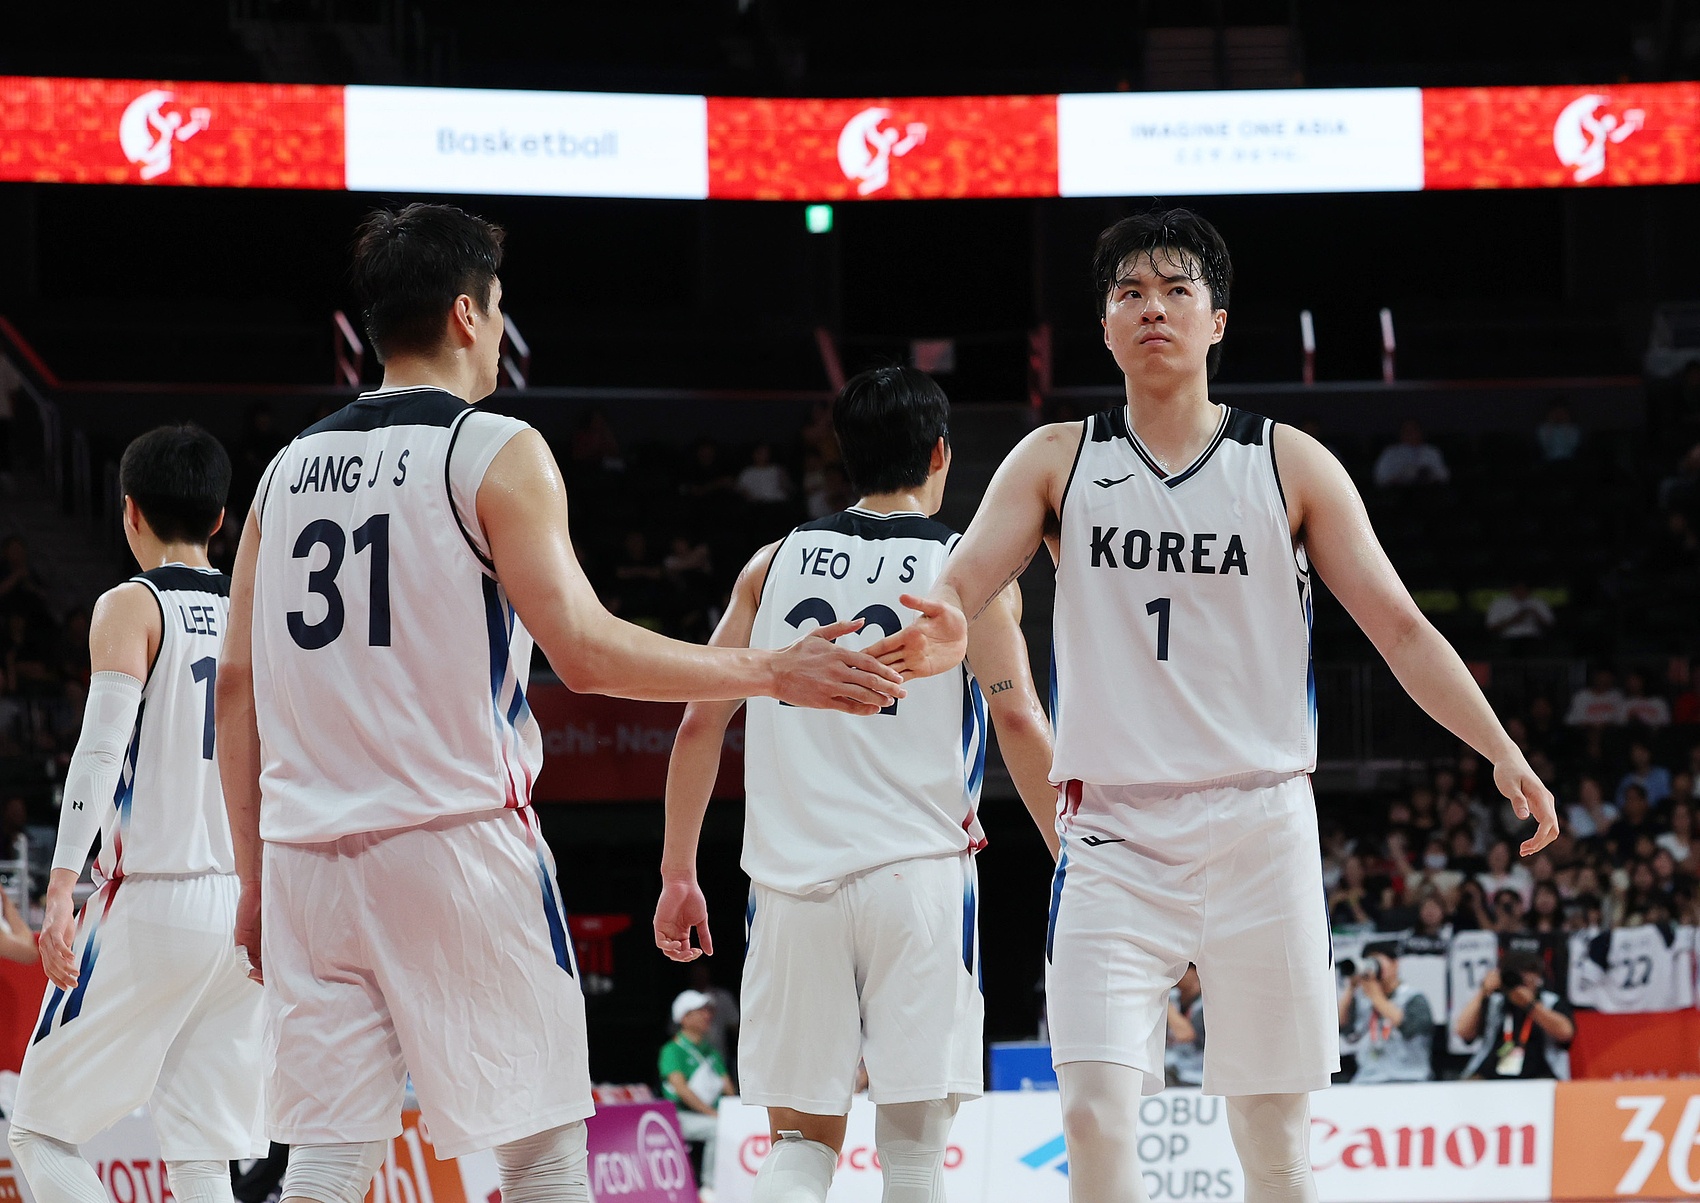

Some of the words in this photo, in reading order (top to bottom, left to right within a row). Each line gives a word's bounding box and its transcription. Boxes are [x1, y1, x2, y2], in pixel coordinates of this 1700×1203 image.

[437, 127, 618, 158] Basketball
[1295, 117, 1348, 136] ASIA
[290, 456, 363, 494] JANG
[368, 451, 384, 488] J
[393, 449, 410, 486] S
[800, 547, 850, 580] YEO
[867, 556, 885, 584] J
[899, 555, 917, 583] S
[1090, 526, 1249, 576] KOREA
[287, 513, 391, 650] 31
[179, 605, 217, 637] LEE
[1145, 597, 1171, 661] 1
[990, 679, 1014, 695] XXII
[190, 656, 217, 760] 1
[1139, 1097, 1217, 1126] OBU
[1137, 1133, 1189, 1163] OP
[1142, 1168, 1233, 1200] OURS
